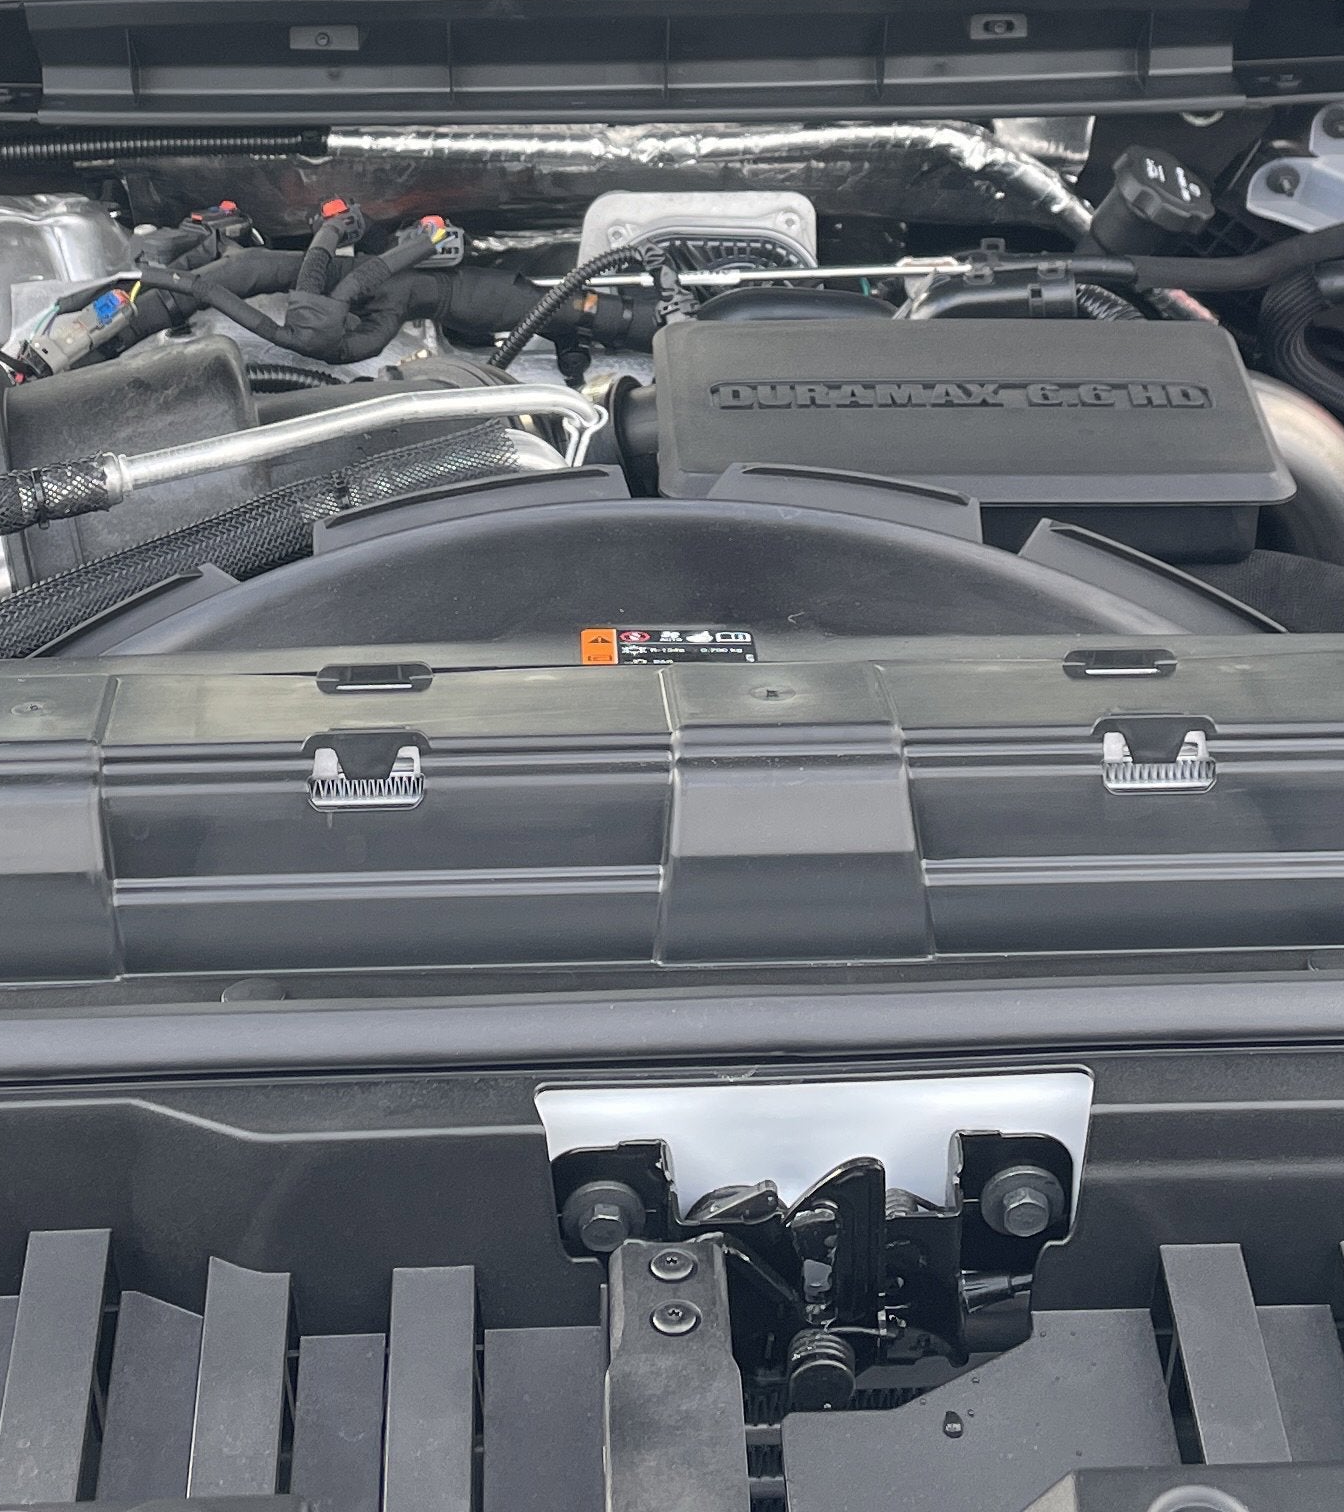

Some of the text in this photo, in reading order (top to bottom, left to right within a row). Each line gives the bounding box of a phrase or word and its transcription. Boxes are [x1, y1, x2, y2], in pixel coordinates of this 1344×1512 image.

[716, 383, 1207, 409] DURAMAX 6.6 HD
